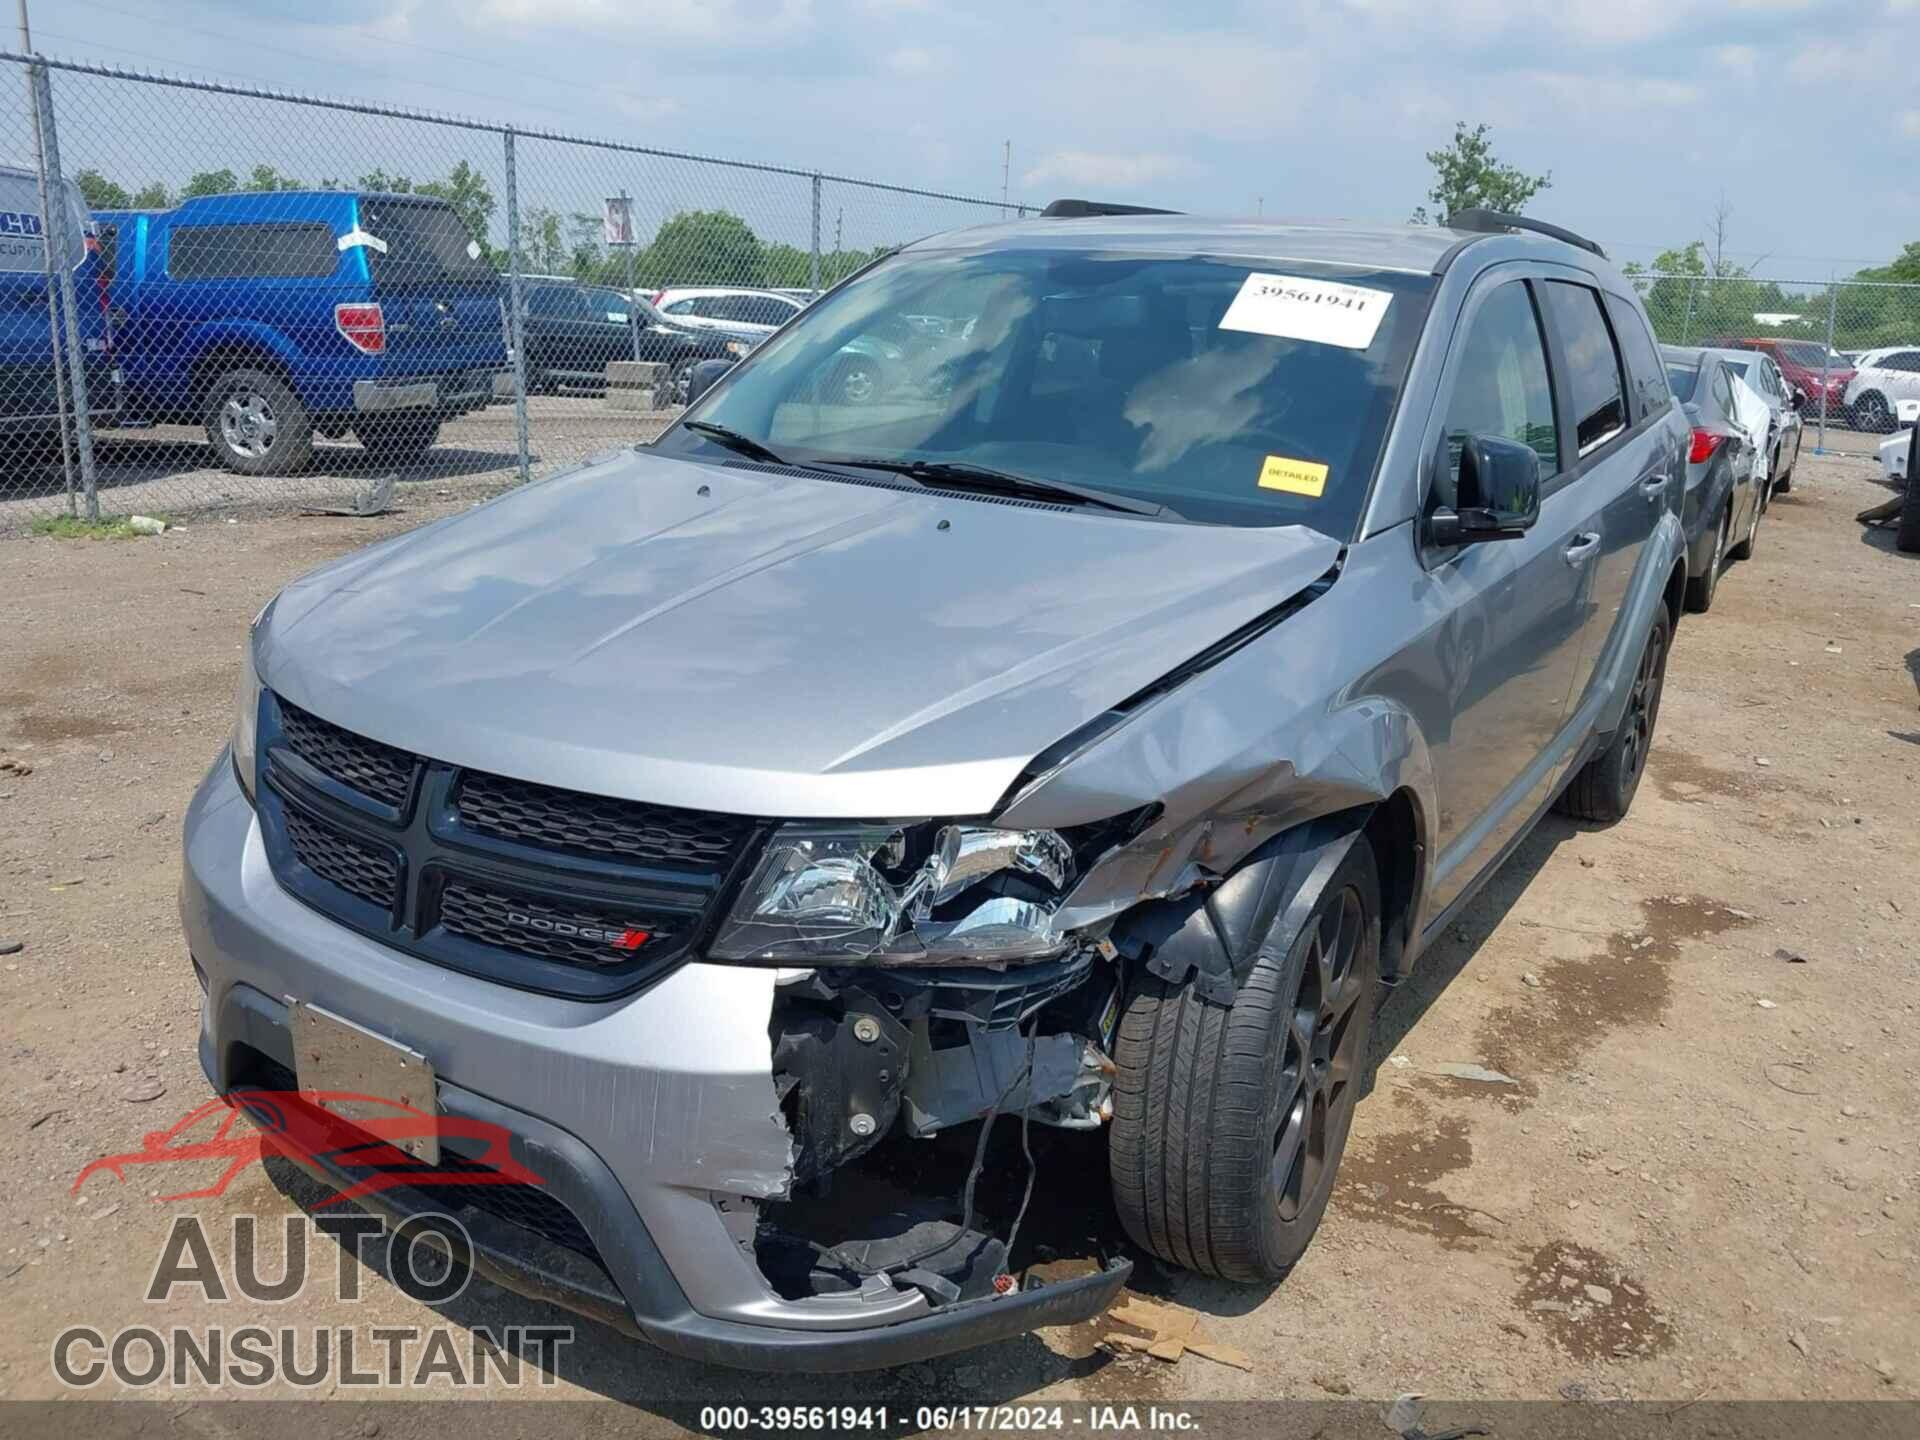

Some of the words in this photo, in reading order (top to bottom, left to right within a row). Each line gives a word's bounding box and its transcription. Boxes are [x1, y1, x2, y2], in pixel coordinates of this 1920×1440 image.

[1252, 285, 1366, 312] 39561941
[1268, 468, 1319, 482] DETAILED
[508, 912, 628, 945] DODGE
